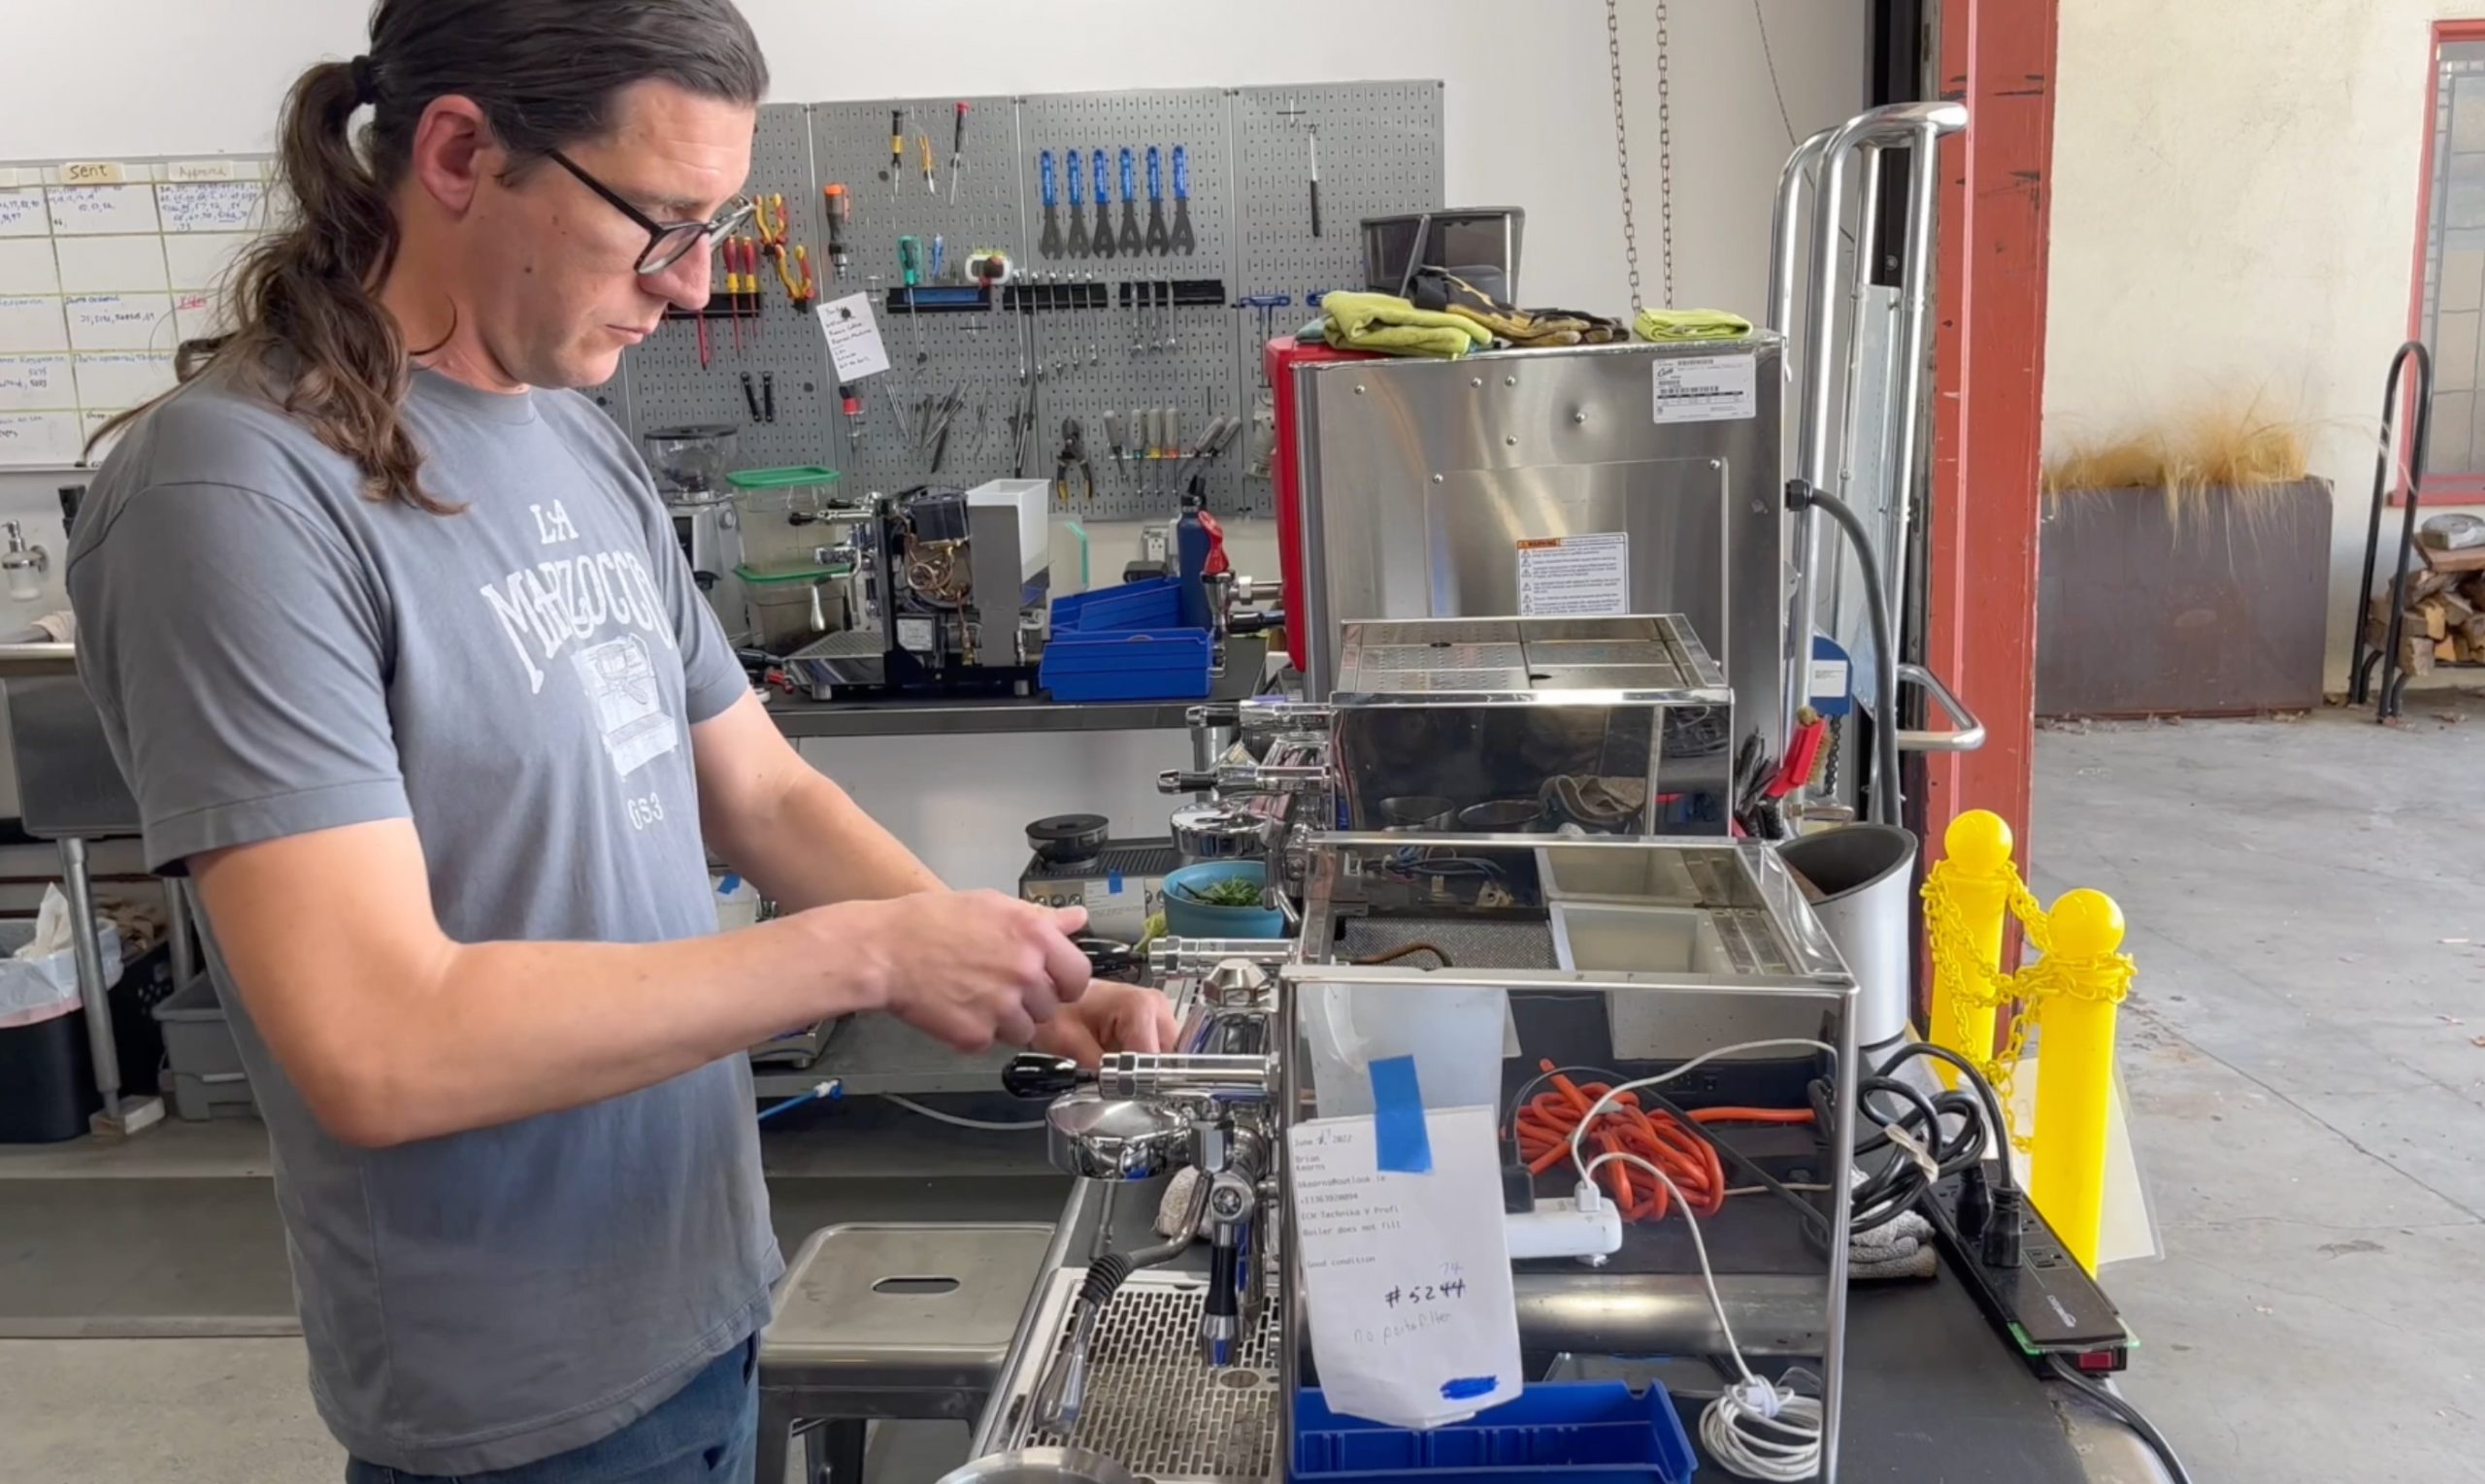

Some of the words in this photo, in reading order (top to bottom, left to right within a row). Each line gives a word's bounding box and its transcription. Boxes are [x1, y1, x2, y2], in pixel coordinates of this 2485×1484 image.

[69, 164, 108, 180] Sent
[529, 499, 580, 544] LA
[480, 550, 673, 694] MARZOCCO
[1381, 1220, 1401, 1229] fill
[1331, 1256, 1375, 1266] condition
